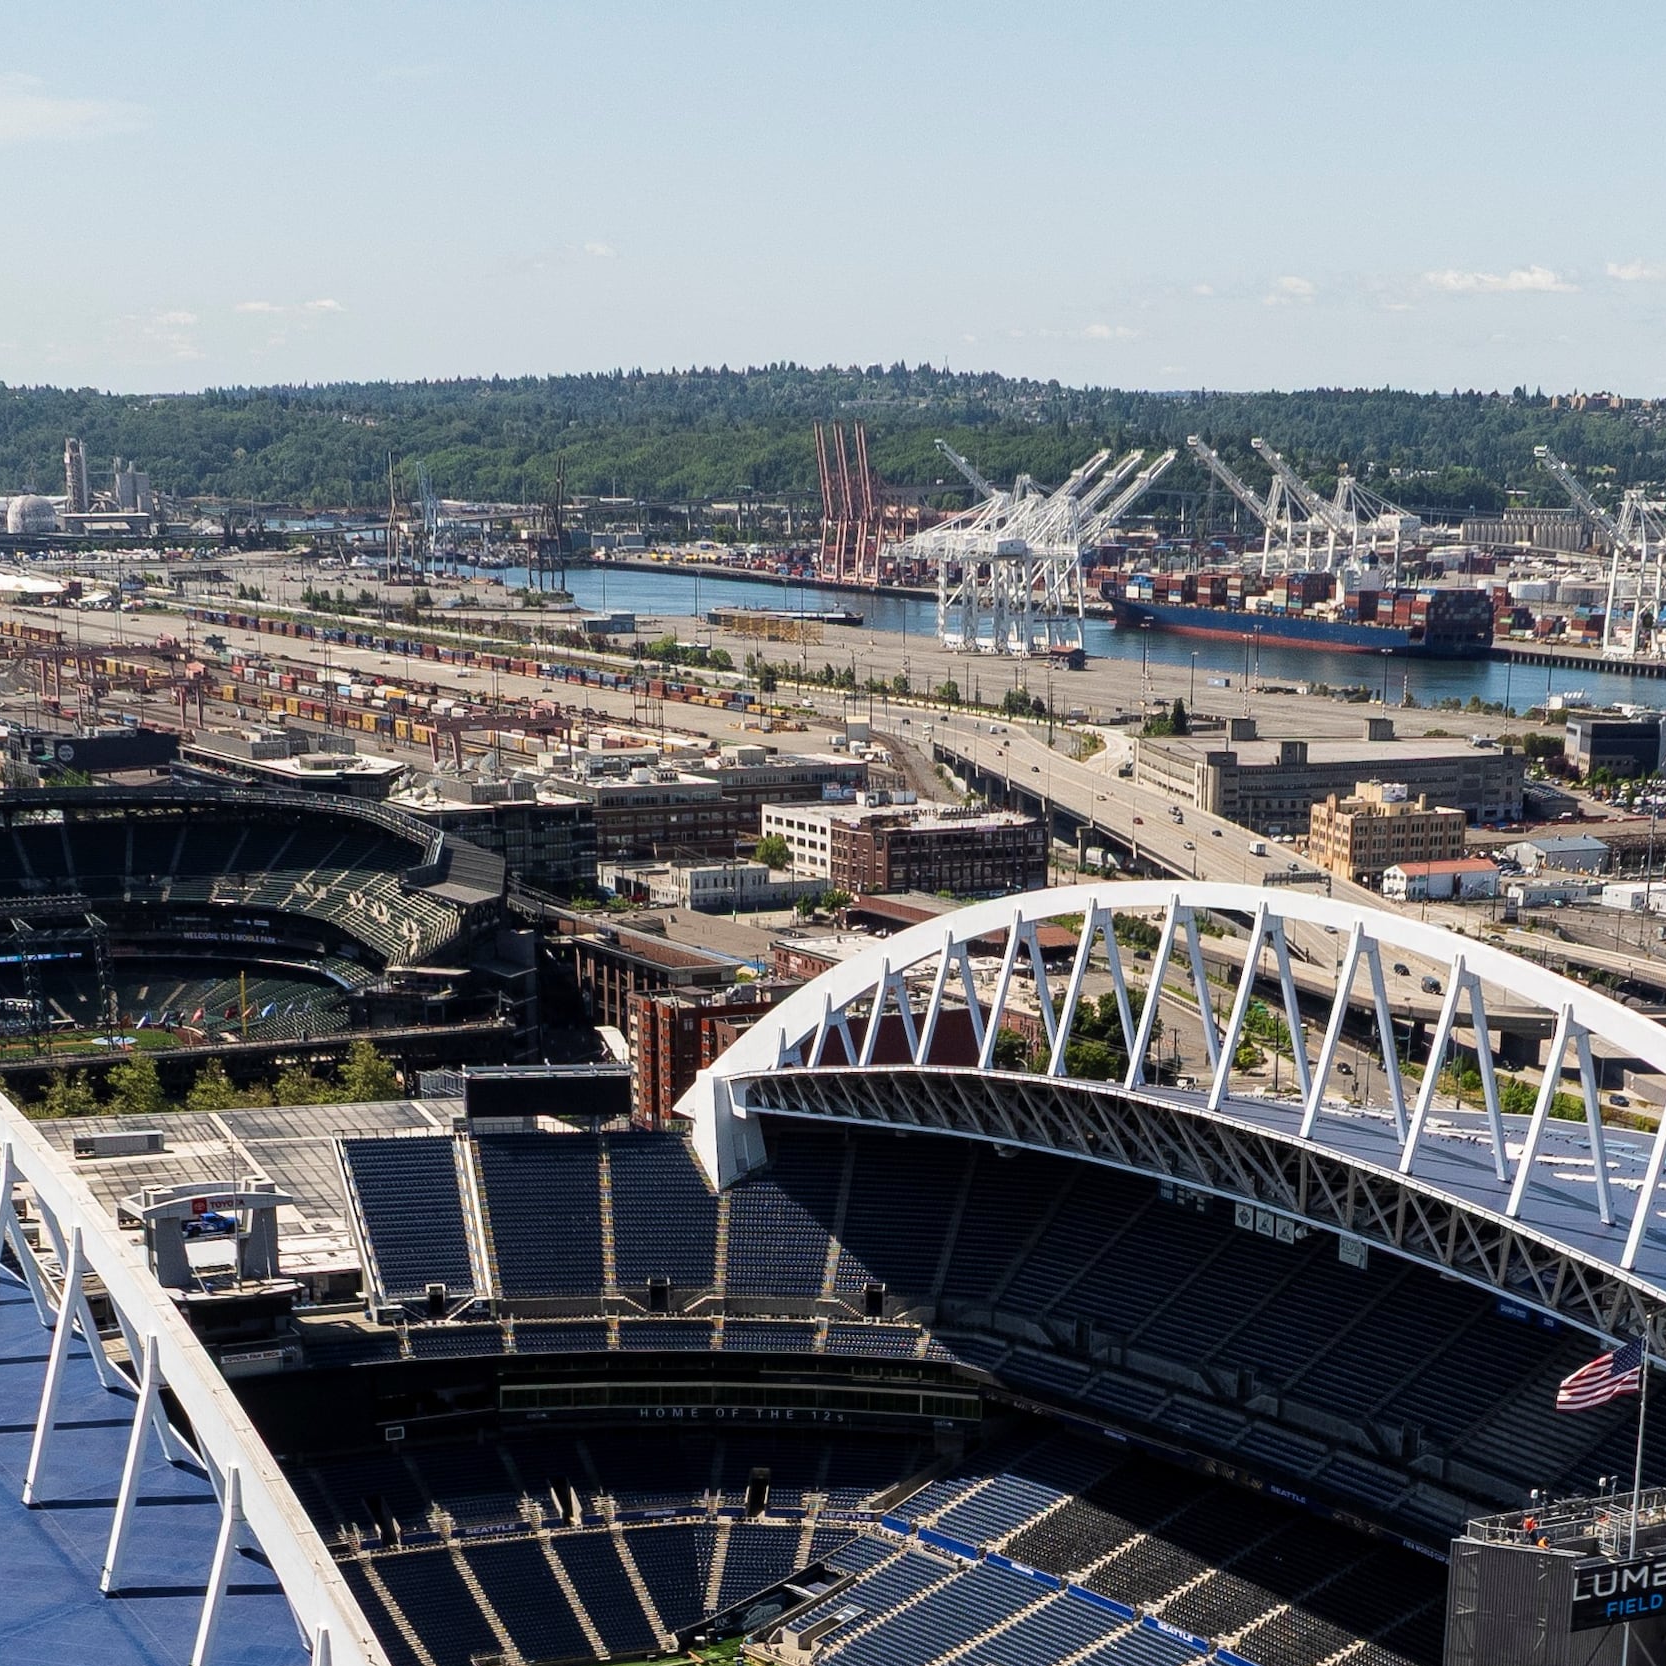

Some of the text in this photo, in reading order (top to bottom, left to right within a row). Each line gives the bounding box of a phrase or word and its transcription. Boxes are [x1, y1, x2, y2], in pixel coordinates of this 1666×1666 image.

[183, 931, 219, 940] WELCOME
[220, 932, 230, 941] TO
[260, 936, 277, 945] PARK
[209, 1199, 245, 1209] TOYOTA
[224, 1351, 280, 1364] TOYOTA FAN DECK
[640, 1408, 844, 1422] HOME OF THE 12s
[1270, 1486, 1307, 1504] SEATTLE
[821, 1511, 872, 1520] SEATTLE
[465, 1524, 515, 1535] SEATTLE
[1606, 1594, 1663, 1618] FIELD
[1158, 1621, 1194, 1643] SEATTLE
